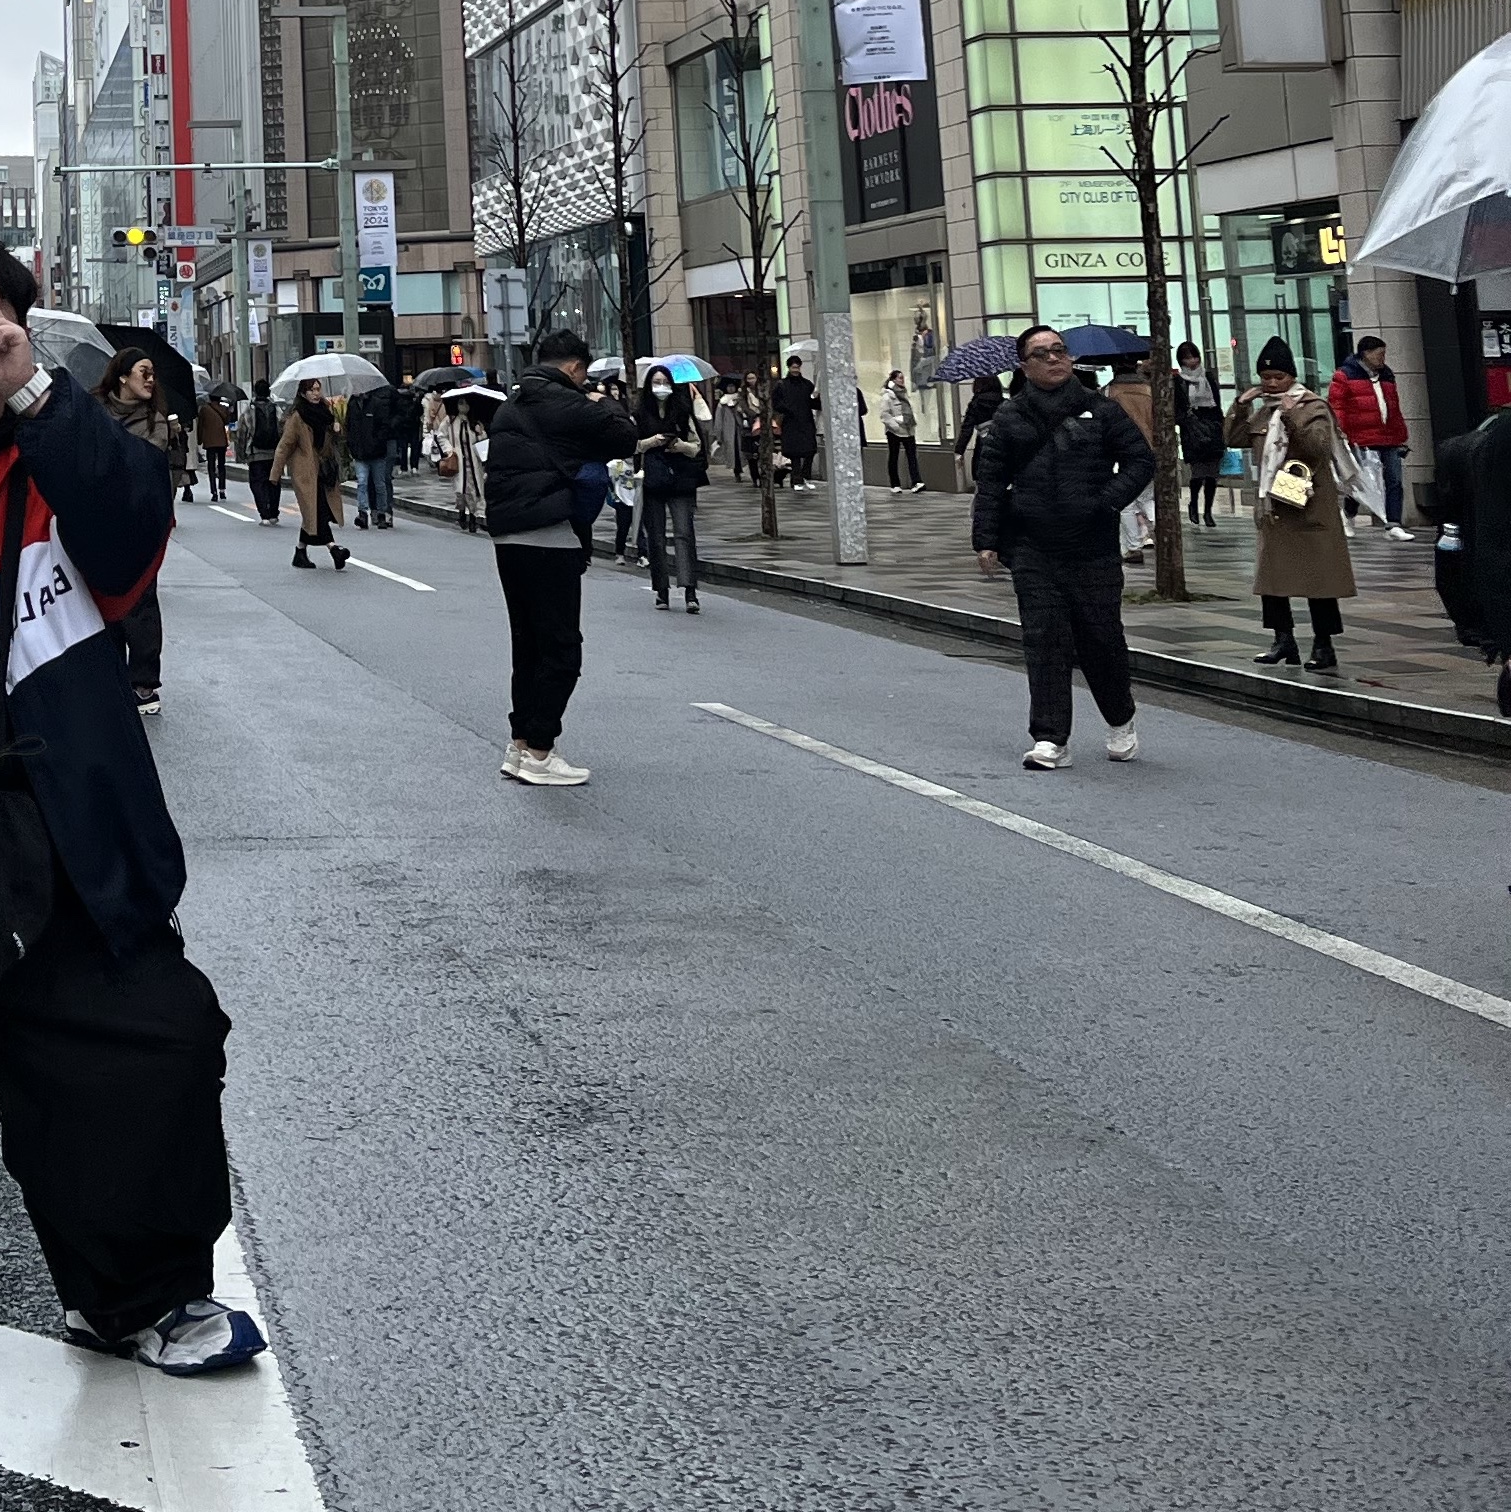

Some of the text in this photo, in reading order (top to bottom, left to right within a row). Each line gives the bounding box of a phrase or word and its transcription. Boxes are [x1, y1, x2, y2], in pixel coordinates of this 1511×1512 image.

[844, 82, 914, 142] Clothes
[1059, 191, 1140, 203] CITY CLUB OF TO
[364, 216, 389, 225] 2024
[1045, 252, 1171, 268] GINZA COE
